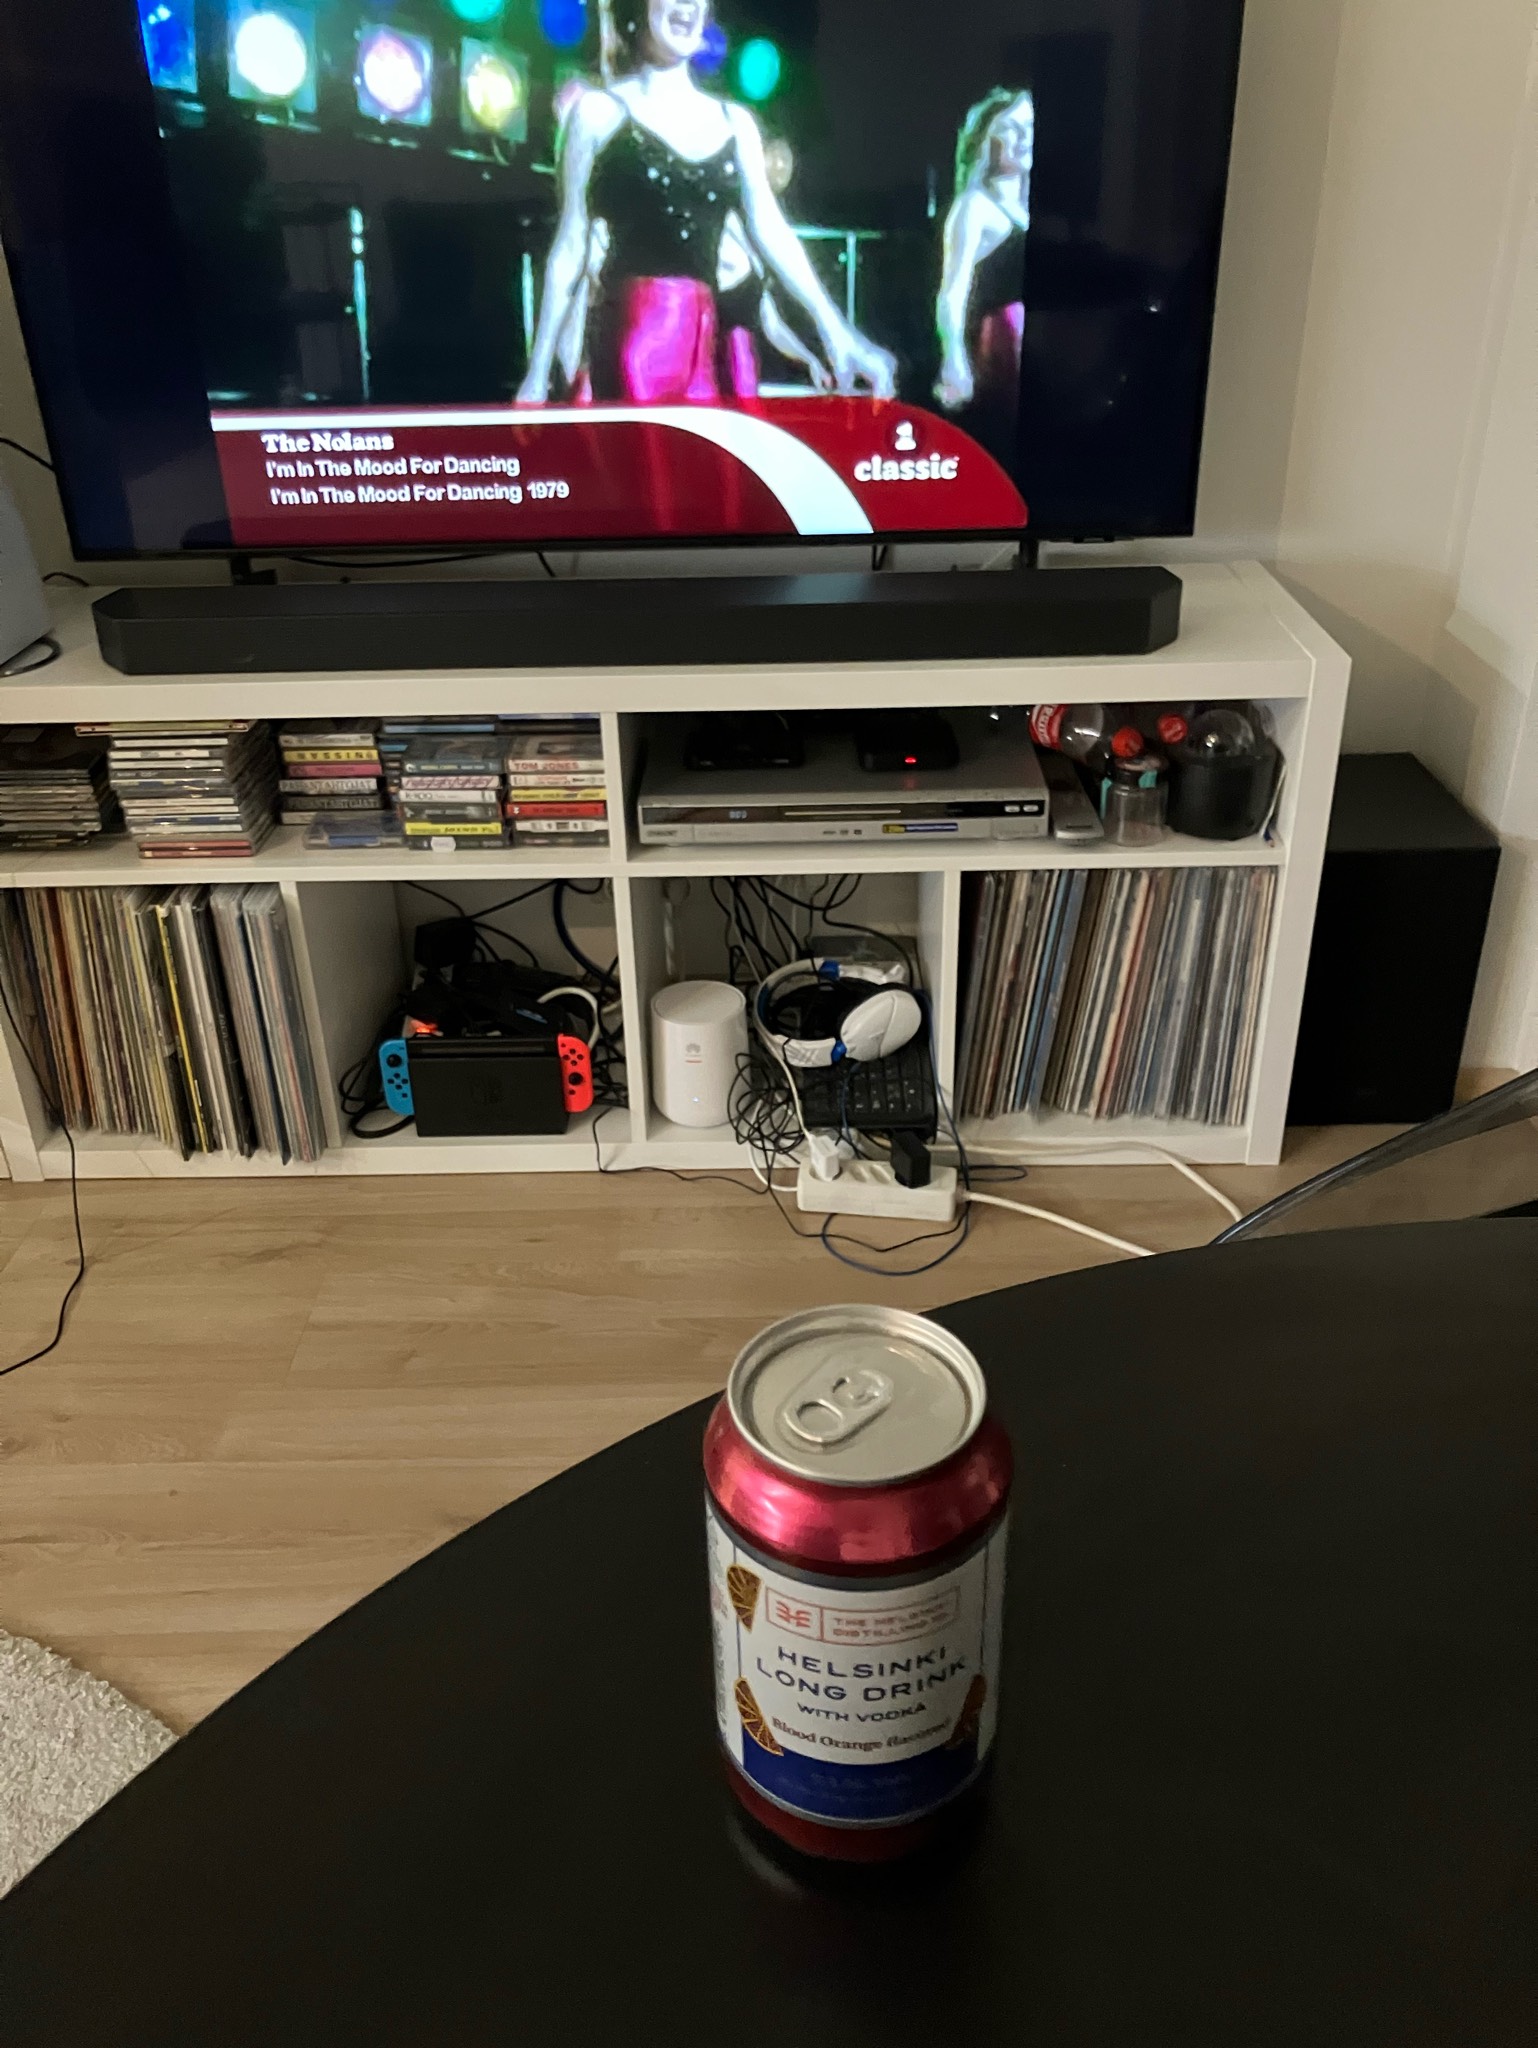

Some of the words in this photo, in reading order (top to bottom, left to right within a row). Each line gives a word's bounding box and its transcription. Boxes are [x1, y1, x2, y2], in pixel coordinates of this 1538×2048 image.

[261, 433, 310, 453] The
[311, 432, 394, 452] Nolans
[266, 459, 296, 478] I'm
[296, 459, 315, 477] In
[314, 458, 352, 477] The
[354, 456, 408, 476] Mood
[410, 456, 442, 474] For
[443, 455, 520, 477] Dancing
[854, 452, 957, 481] classic
[270, 487, 299, 505] I'm
[300, 487, 319, 504] In
[318, 486, 356, 503] The
[357, 485, 411, 503] Mood
[413, 483, 446, 501] For
[447, 482, 523, 504] Dancing
[527, 480, 570, 499] 1979
[514, 762, 539, 771] TOM
[543, 761, 580, 771] JONES
[834, 1617, 866, 1627] THE
[778, 1645, 946, 1679] HELSINKI
[757, 1657, 848, 1701] LONG
[863, 1655, 966, 1702] DRINK
[797, 1701, 849, 1722] WITH
[857, 1701, 928, 1723] VODKA
[772, 1715, 816, 1743] Blood
[819, 1735, 884, 1751] Orange
